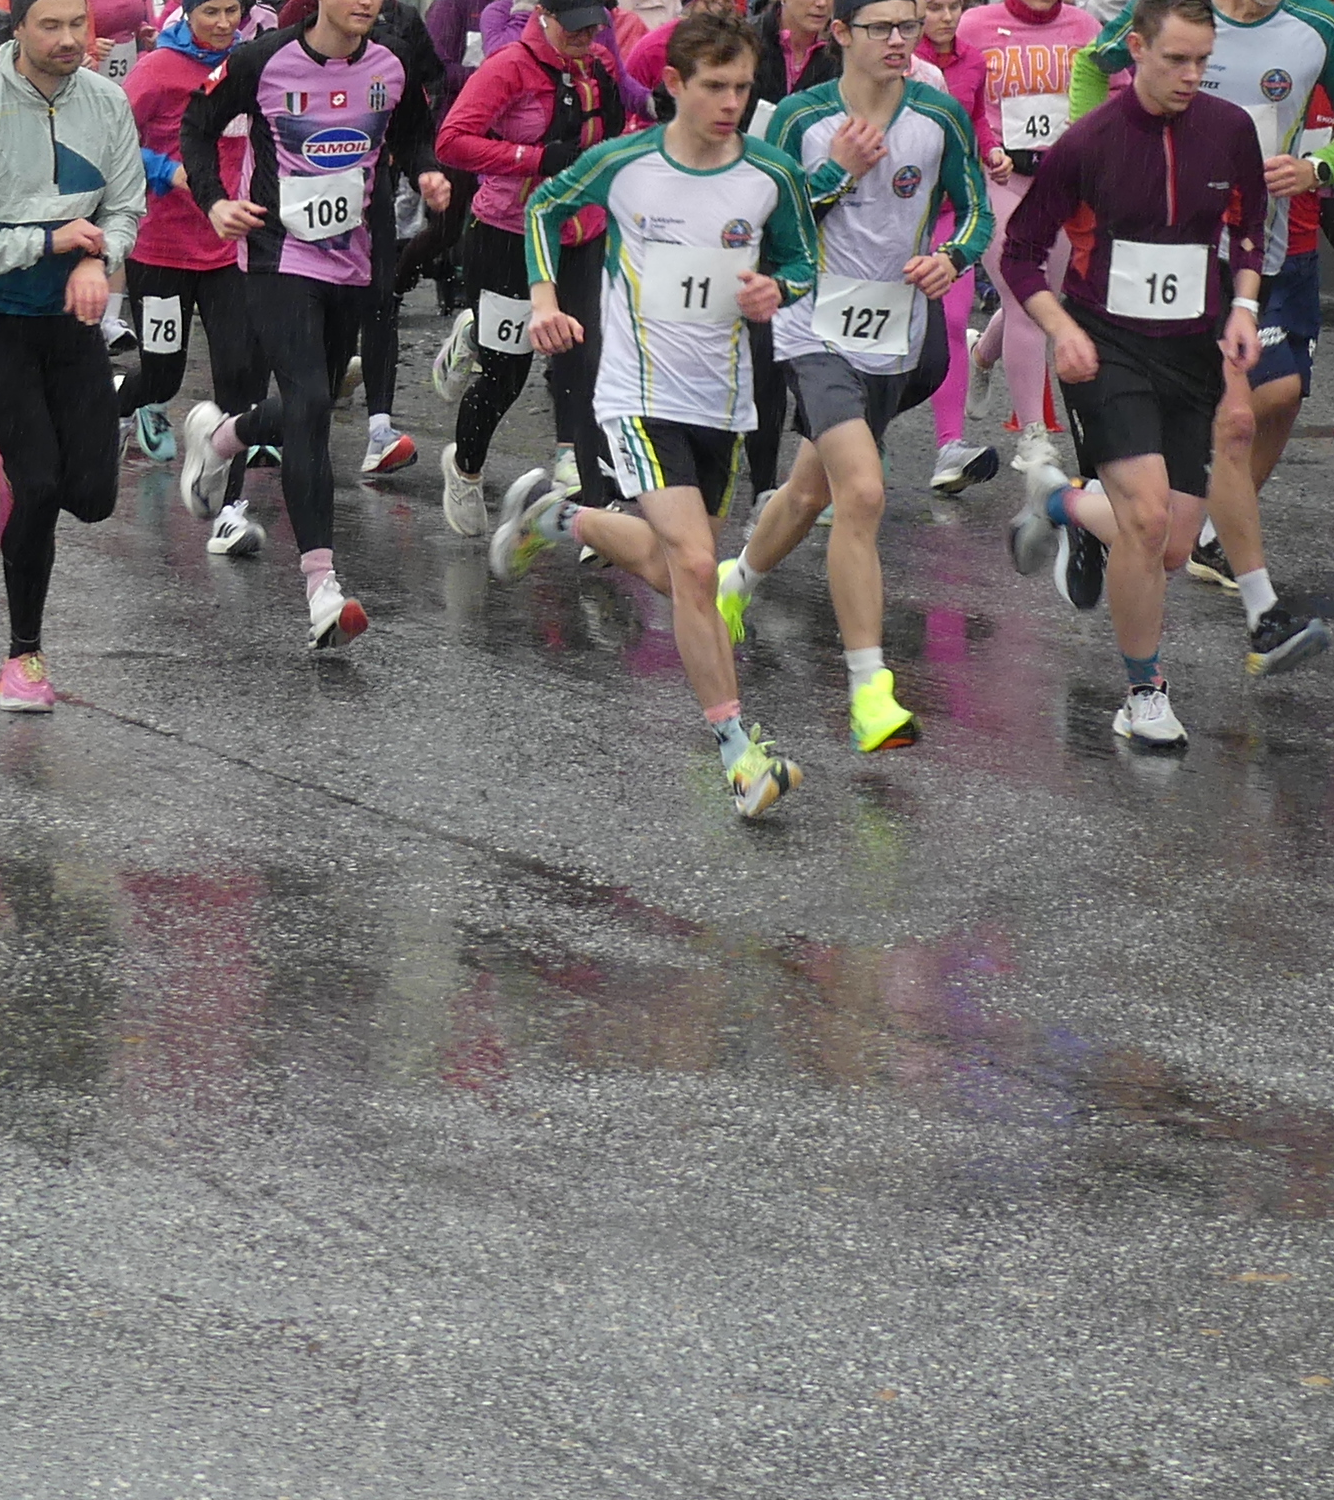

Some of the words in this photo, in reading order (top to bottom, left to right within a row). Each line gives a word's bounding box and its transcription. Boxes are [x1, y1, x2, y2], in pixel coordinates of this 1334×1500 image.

[108, 59, 128, 78] 53
[1025, 114, 1051, 138] 43
[304, 140, 369, 156] TAMOIL
[303, 196, 348, 229] 108
[681, 275, 711, 309] 11
[1145, 272, 1178, 305] 16
[149, 317, 177, 343] 78
[497, 318, 525, 345] 61
[841, 305, 891, 340] 127
